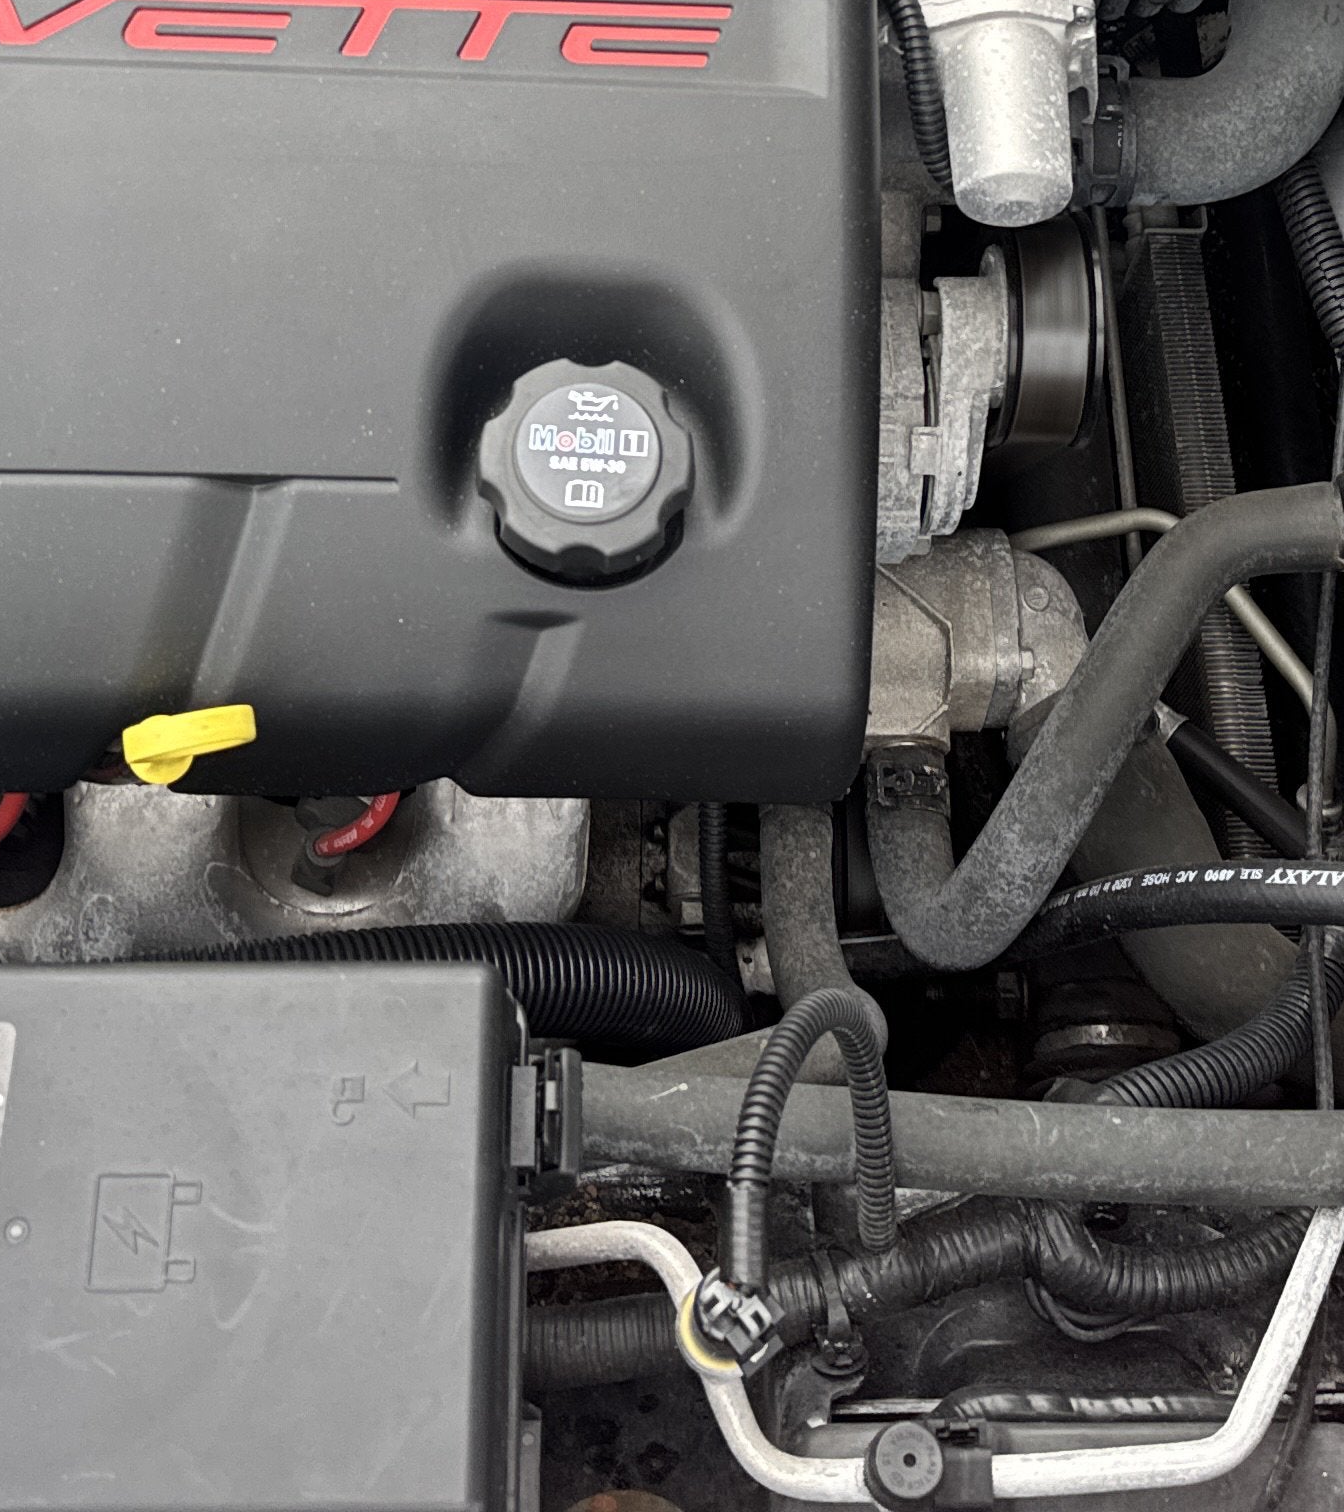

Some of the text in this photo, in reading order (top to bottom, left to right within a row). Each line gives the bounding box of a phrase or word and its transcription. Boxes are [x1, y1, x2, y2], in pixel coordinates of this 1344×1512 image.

[528, 423, 616, 456] Mobil
[548, 455, 627, 474] SAE 5W-30
[1141, 872, 1171, 887] HOSE
[1175, 869, 1198, 884] A/C
[1205, 868, 1236, 882] 4890
